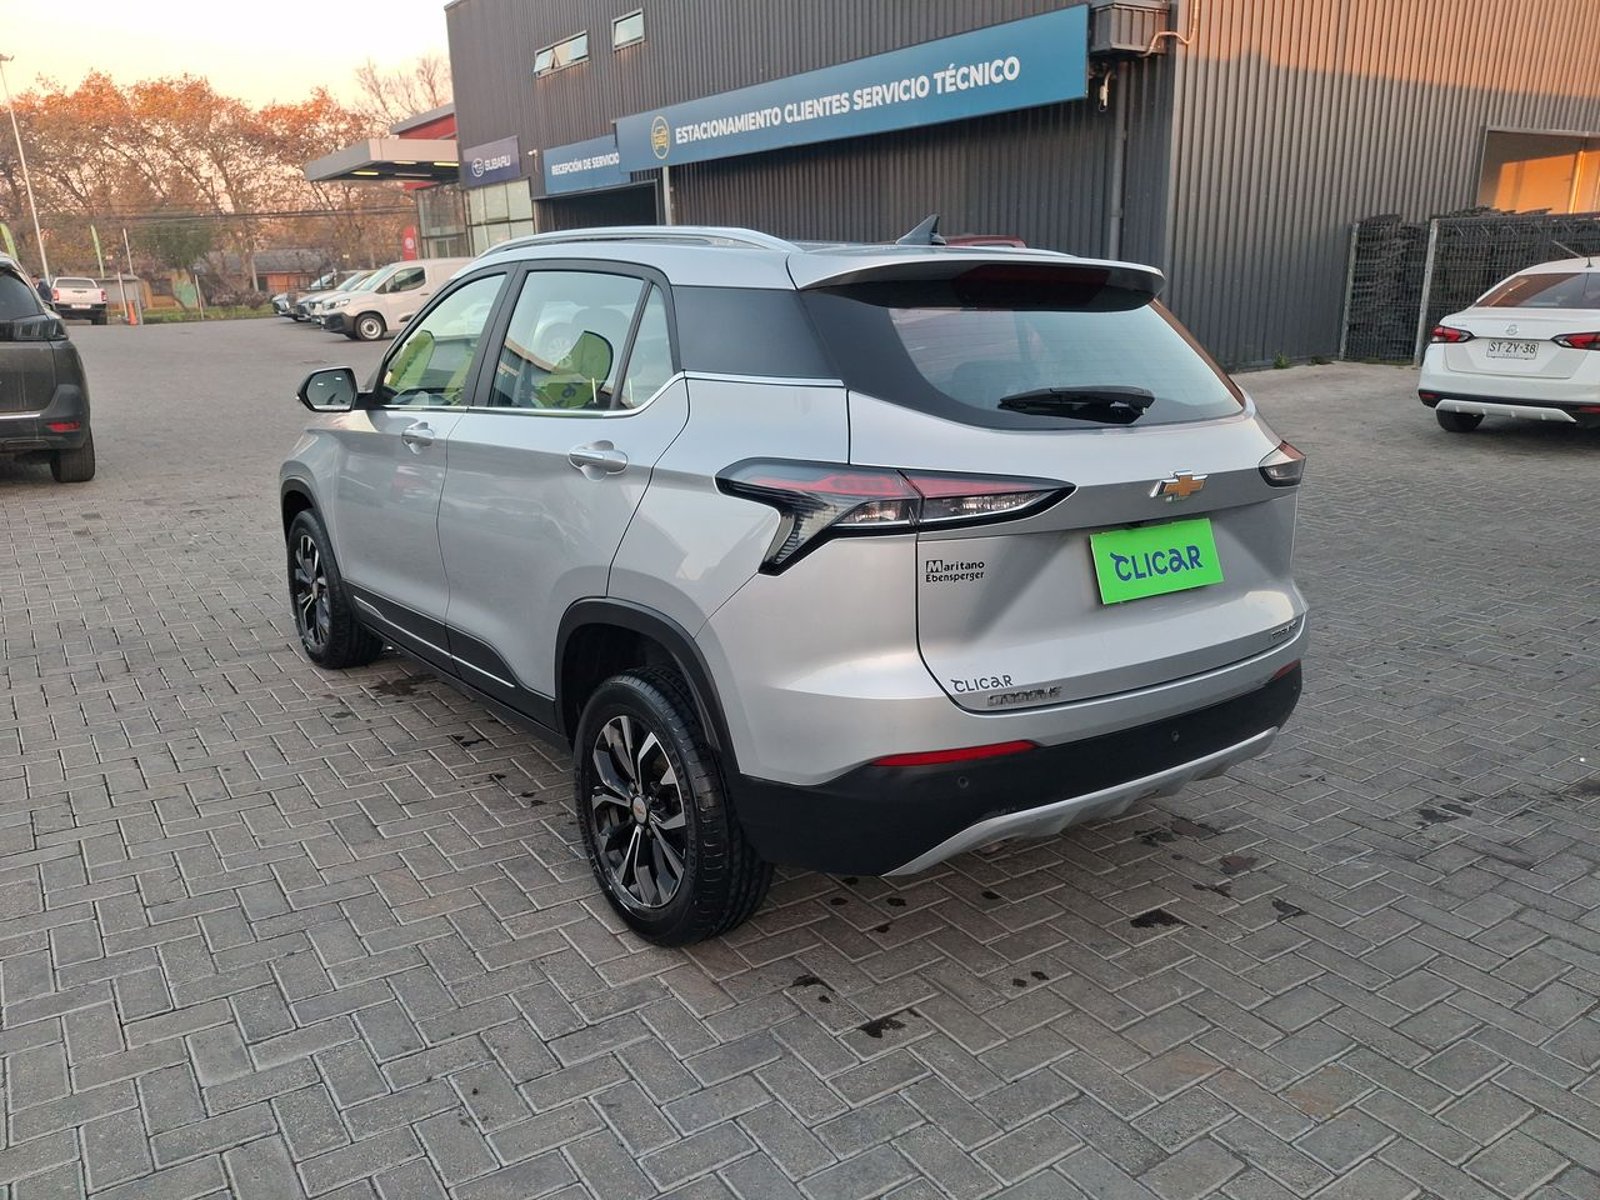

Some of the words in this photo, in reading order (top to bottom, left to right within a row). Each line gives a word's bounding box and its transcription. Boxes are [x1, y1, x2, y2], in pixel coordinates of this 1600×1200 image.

[675, 106, 781, 144] ESTACIONAMIENTO
[784, 92, 850, 123] CLIENTES
[853, 75, 930, 110] SERVICIO
[933, 56, 1021, 94] TÉCNICO
[484, 154, 511, 171] SUBARU
[551, 158, 583, 176] RECEPCIÓN
[583, 159, 593, 170] DE
[592, 152, 620, 169] SERVICIO
[926, 560, 985, 574] Maritano
[925, 571, 985, 583] Ebensperger
